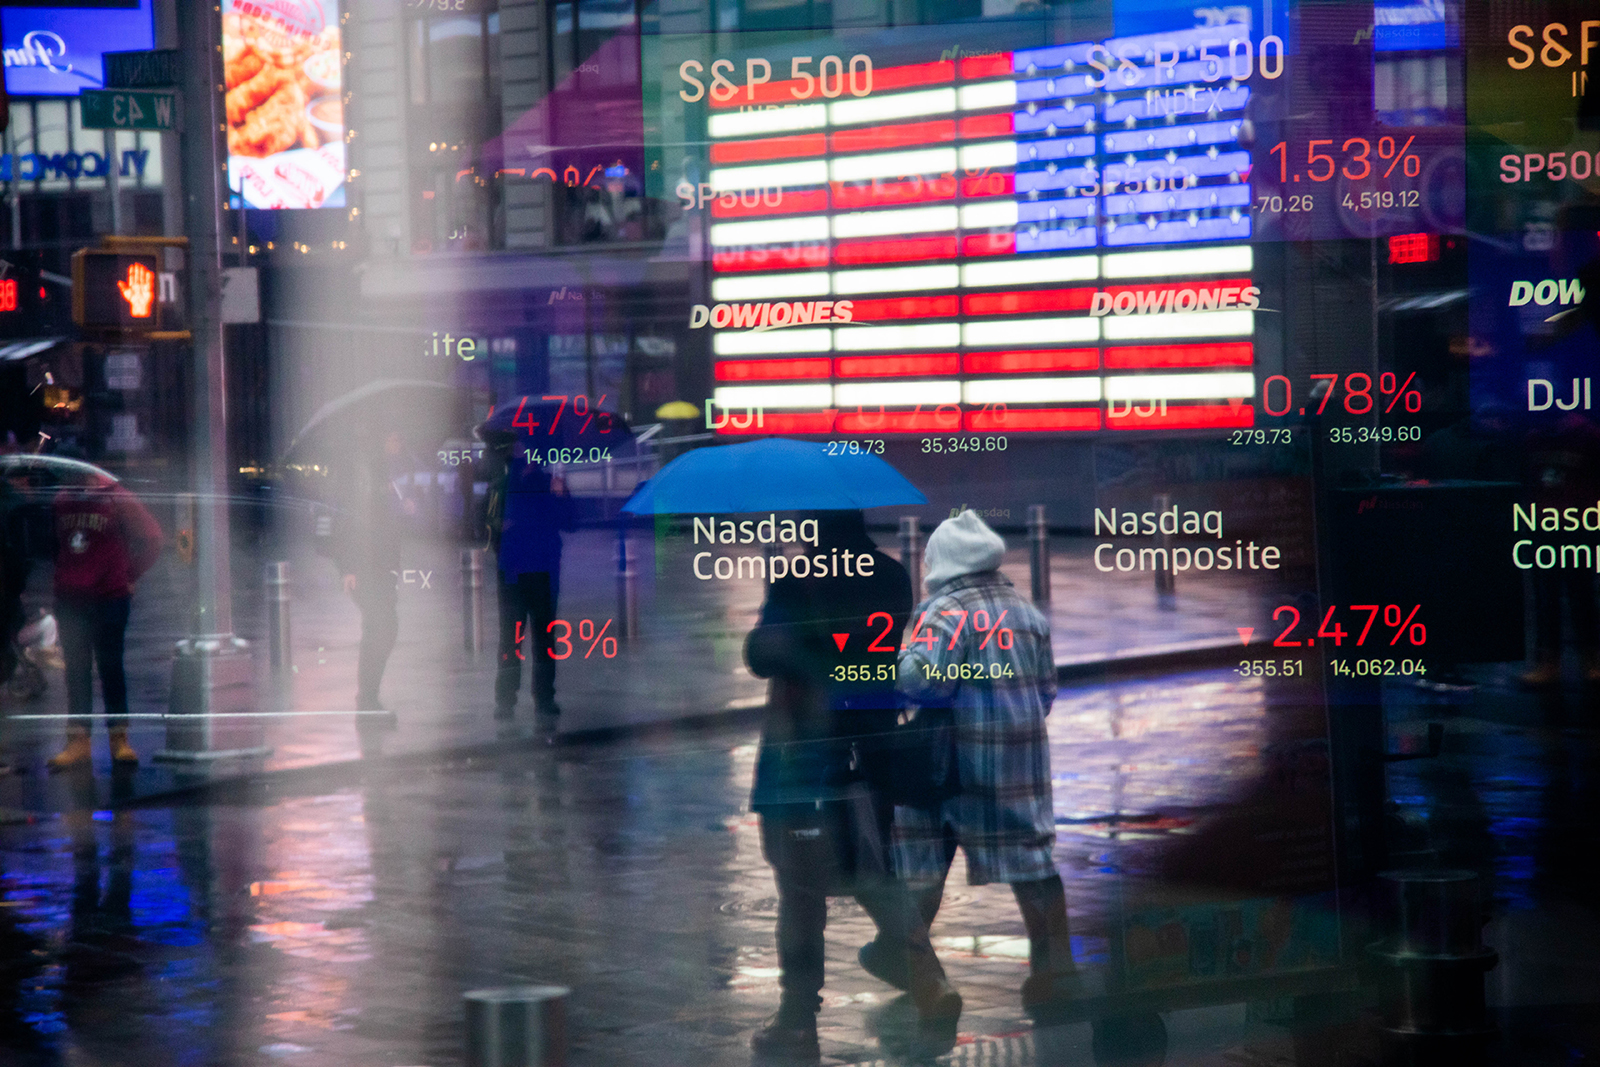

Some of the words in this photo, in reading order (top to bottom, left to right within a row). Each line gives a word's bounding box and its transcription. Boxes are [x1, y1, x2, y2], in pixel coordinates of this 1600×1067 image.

[1086, 42, 1180, 88] S&P
[1201, 35, 1284, 82] 500
[679, 58, 772, 102] S&P
[790, 54, 873, 99] 500
[1269, 135, 1421, 183] 1.53%
[675, 180, 784, 211] SP500
[1252, 195, 1314, 213] -70.26
[1341, 190, 1420, 212] 4,519.12
[689, 300, 855, 331] DOWJONES
[424, 332, 476, 361] ite
[1263, 371, 1422, 417] 0.78%
[1528, 377, 1591, 411] DJI
[705, 397, 765, 429] DJI
[822, 440, 886, 456] -279.73
[921, 436, 1008, 455] 35,349.60
[1227, 429, 1292, 445] -279.73
[1329, 426, 1421, 445] 35,349.60
[523, 446, 613, 467] 14,062.04
[974, 506, 1010, 519] asdaq
[1094, 505, 1223, 539] Nasdaq
[693, 514, 819, 547] Nasdaq
[693, 548, 875, 583] Composite
[1094, 540, 1281, 575] Composite
[867, 609, 1014, 652] 2.47%
[1272, 604, 1427, 647] 2.47%
[829, 664, 897, 682] -355.51
[922, 662, 1015, 682] 14,062.04
[1233, 659, 1303, 677] -355.51
[1330, 659, 1427, 678] 14,062.04
